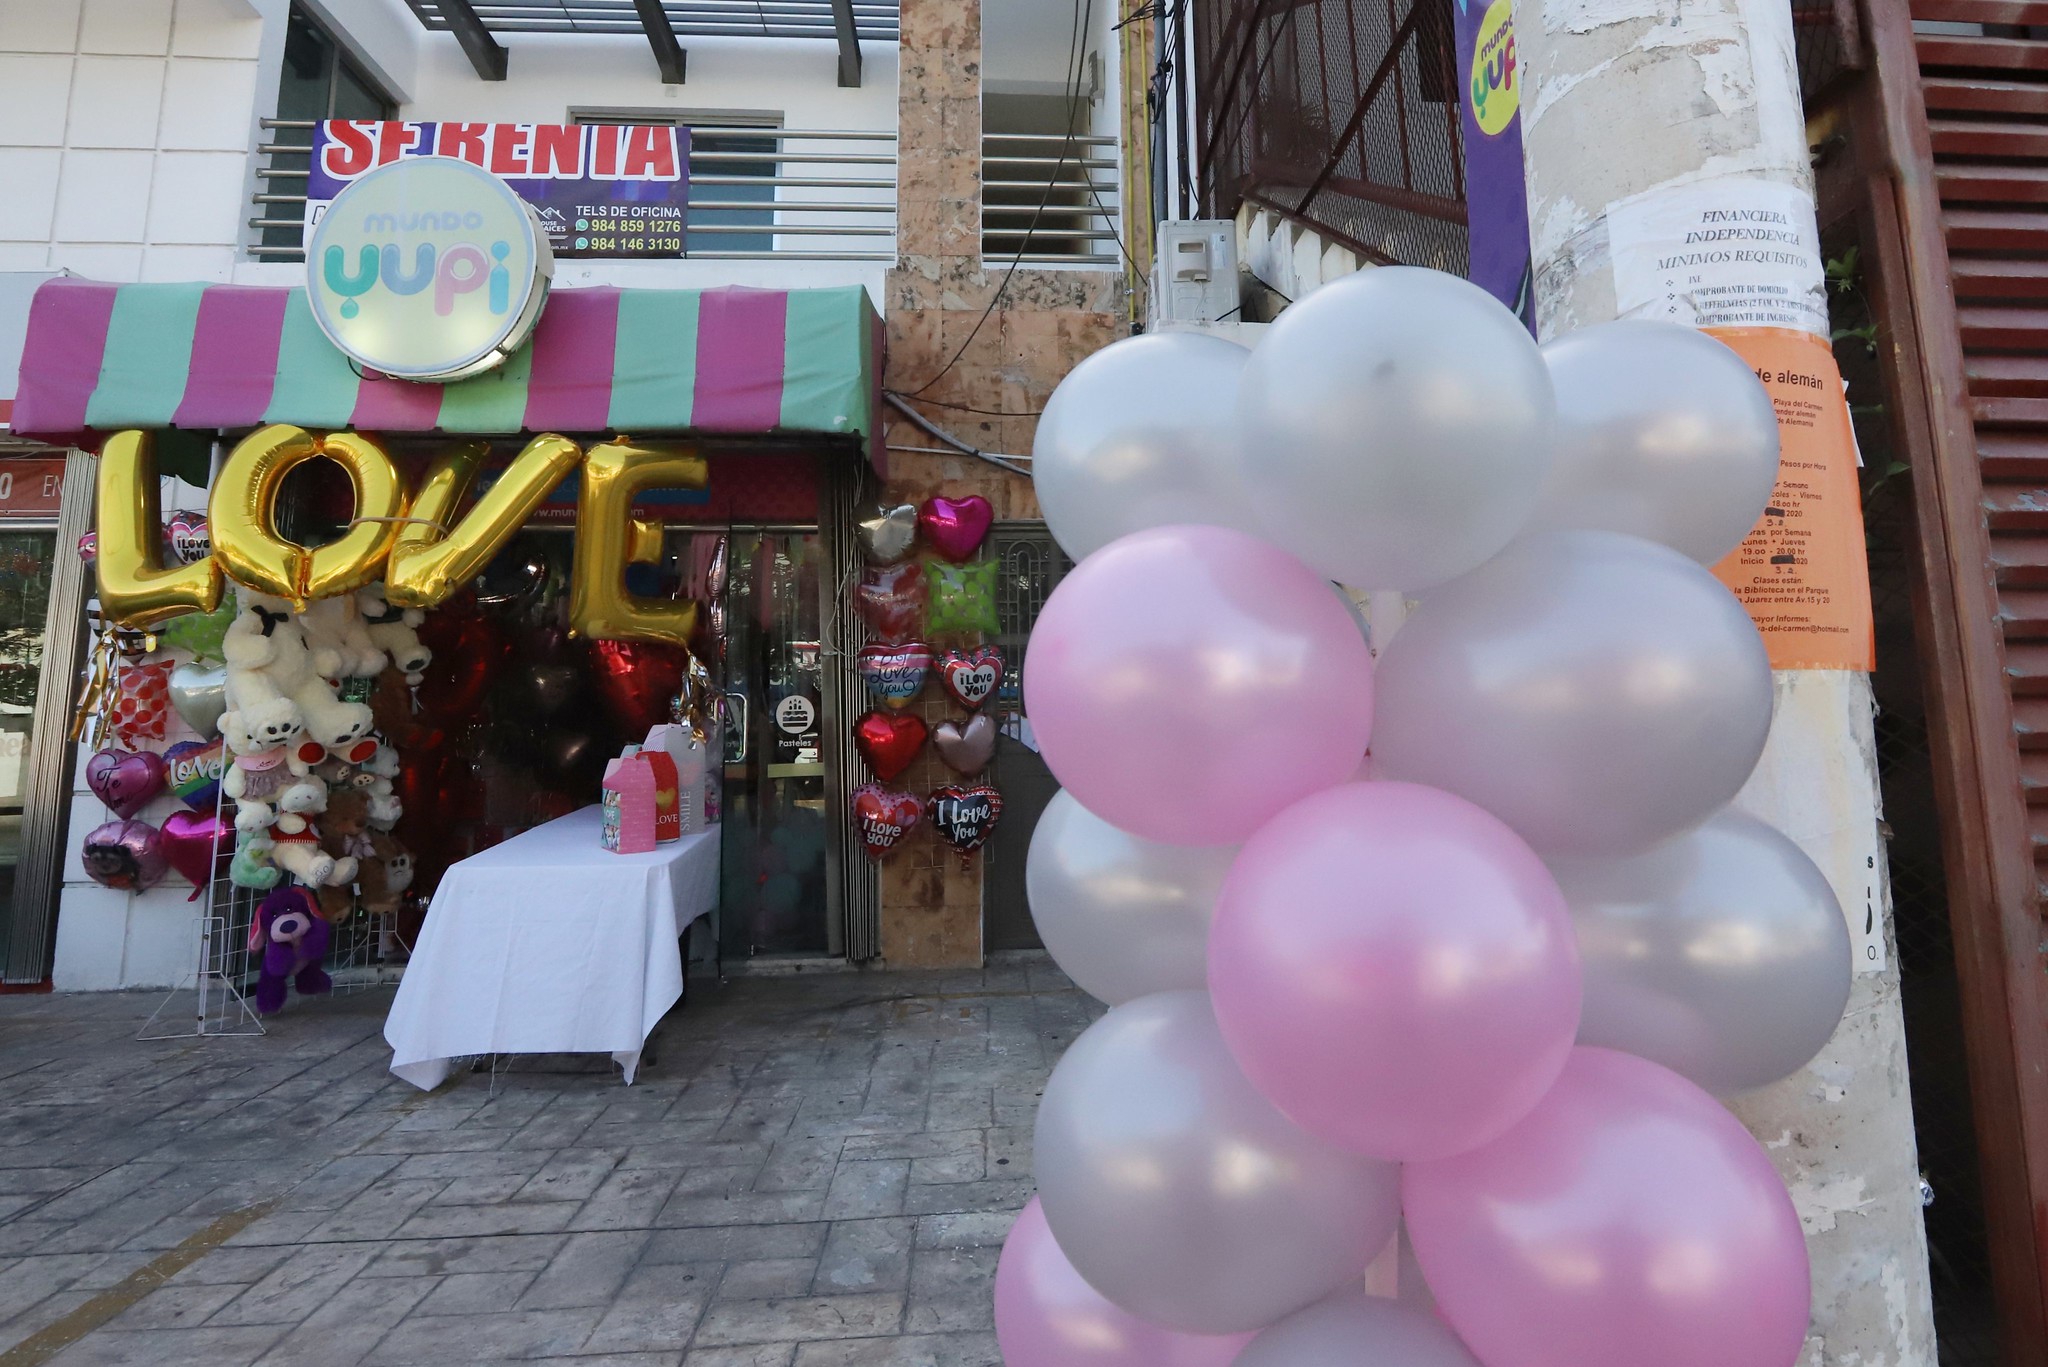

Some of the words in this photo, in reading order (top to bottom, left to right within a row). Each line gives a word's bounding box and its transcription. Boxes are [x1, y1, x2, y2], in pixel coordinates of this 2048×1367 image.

[575, 205, 607, 216] TELS
[610, 206, 628, 217] DE
[631, 206, 682, 218] OFICINA
[1702, 209, 1788, 225] FINANCIERA
[591, 219, 616, 232] 984
[620, 219, 644, 232] 859
[648, 220, 681, 233] 1276
[1685, 228, 1800, 246] INDEPENDENCIA
[591, 237, 616, 250] 984
[620, 238, 644, 250] 146
[648, 238, 680, 250] 3130
[1656, 250, 1731, 271] MINIMOS
[1734, 250, 1809, 269] REQUISITOS
[1746, 285, 1756, 293] DE
[1695, 312, 1755, 325] COMPROBANTE
[1755, 312, 1766, 321] DE
[1777, 369, 1823, 390] alemán
[1773, 398, 1792, 408] Playa
[1792, 400, 1803, 408] del
[1803, 401, 1823, 411] Carmen
[1796, 409, 1816, 419] alemán
[1785, 418, 1814, 428] Alemania
[1780, 459, 1801, 468] Pesos
[1802, 461, 1813, 470] por
[1813, 463, 1827, 471] Hora
[1783, 480, 1809, 490] Semana
[1792, 500, 1801, 508] hr
[1786, 510, 1803, 518] 2020
[97, 424, 709, 645] LOVE
[1770, 529, 1783, 539] por
[1784, 528, 1812, 537] Semana
[1780, 538, 1806, 546] Jueves
[1776, 547, 1796, 555] 20.00
[1797, 547, 1805, 555] hr
[1740, 557, 1764, 565] Inicio
[1752, 576, 1780, 584] Clases
[1781, 576, 1804, 584] están:
[1744, 586, 1785, 594] Biblioteca
[1797, 586, 1804, 594] el
[1805, 586, 1829, 595] Parque
[1744, 596, 1772, 604] Juarez
[1822, 596, 1830, 604] 20
[1775, 615, 1811, 623] Informes:
[778, 738, 812, 748] Pasteles
[681, 791, 691, 831] SMILE
[937, 799, 947, 827] I
[951, 799, 991, 825] Love
[863, 818, 869, 831] I
[952, 823, 979, 843] You
